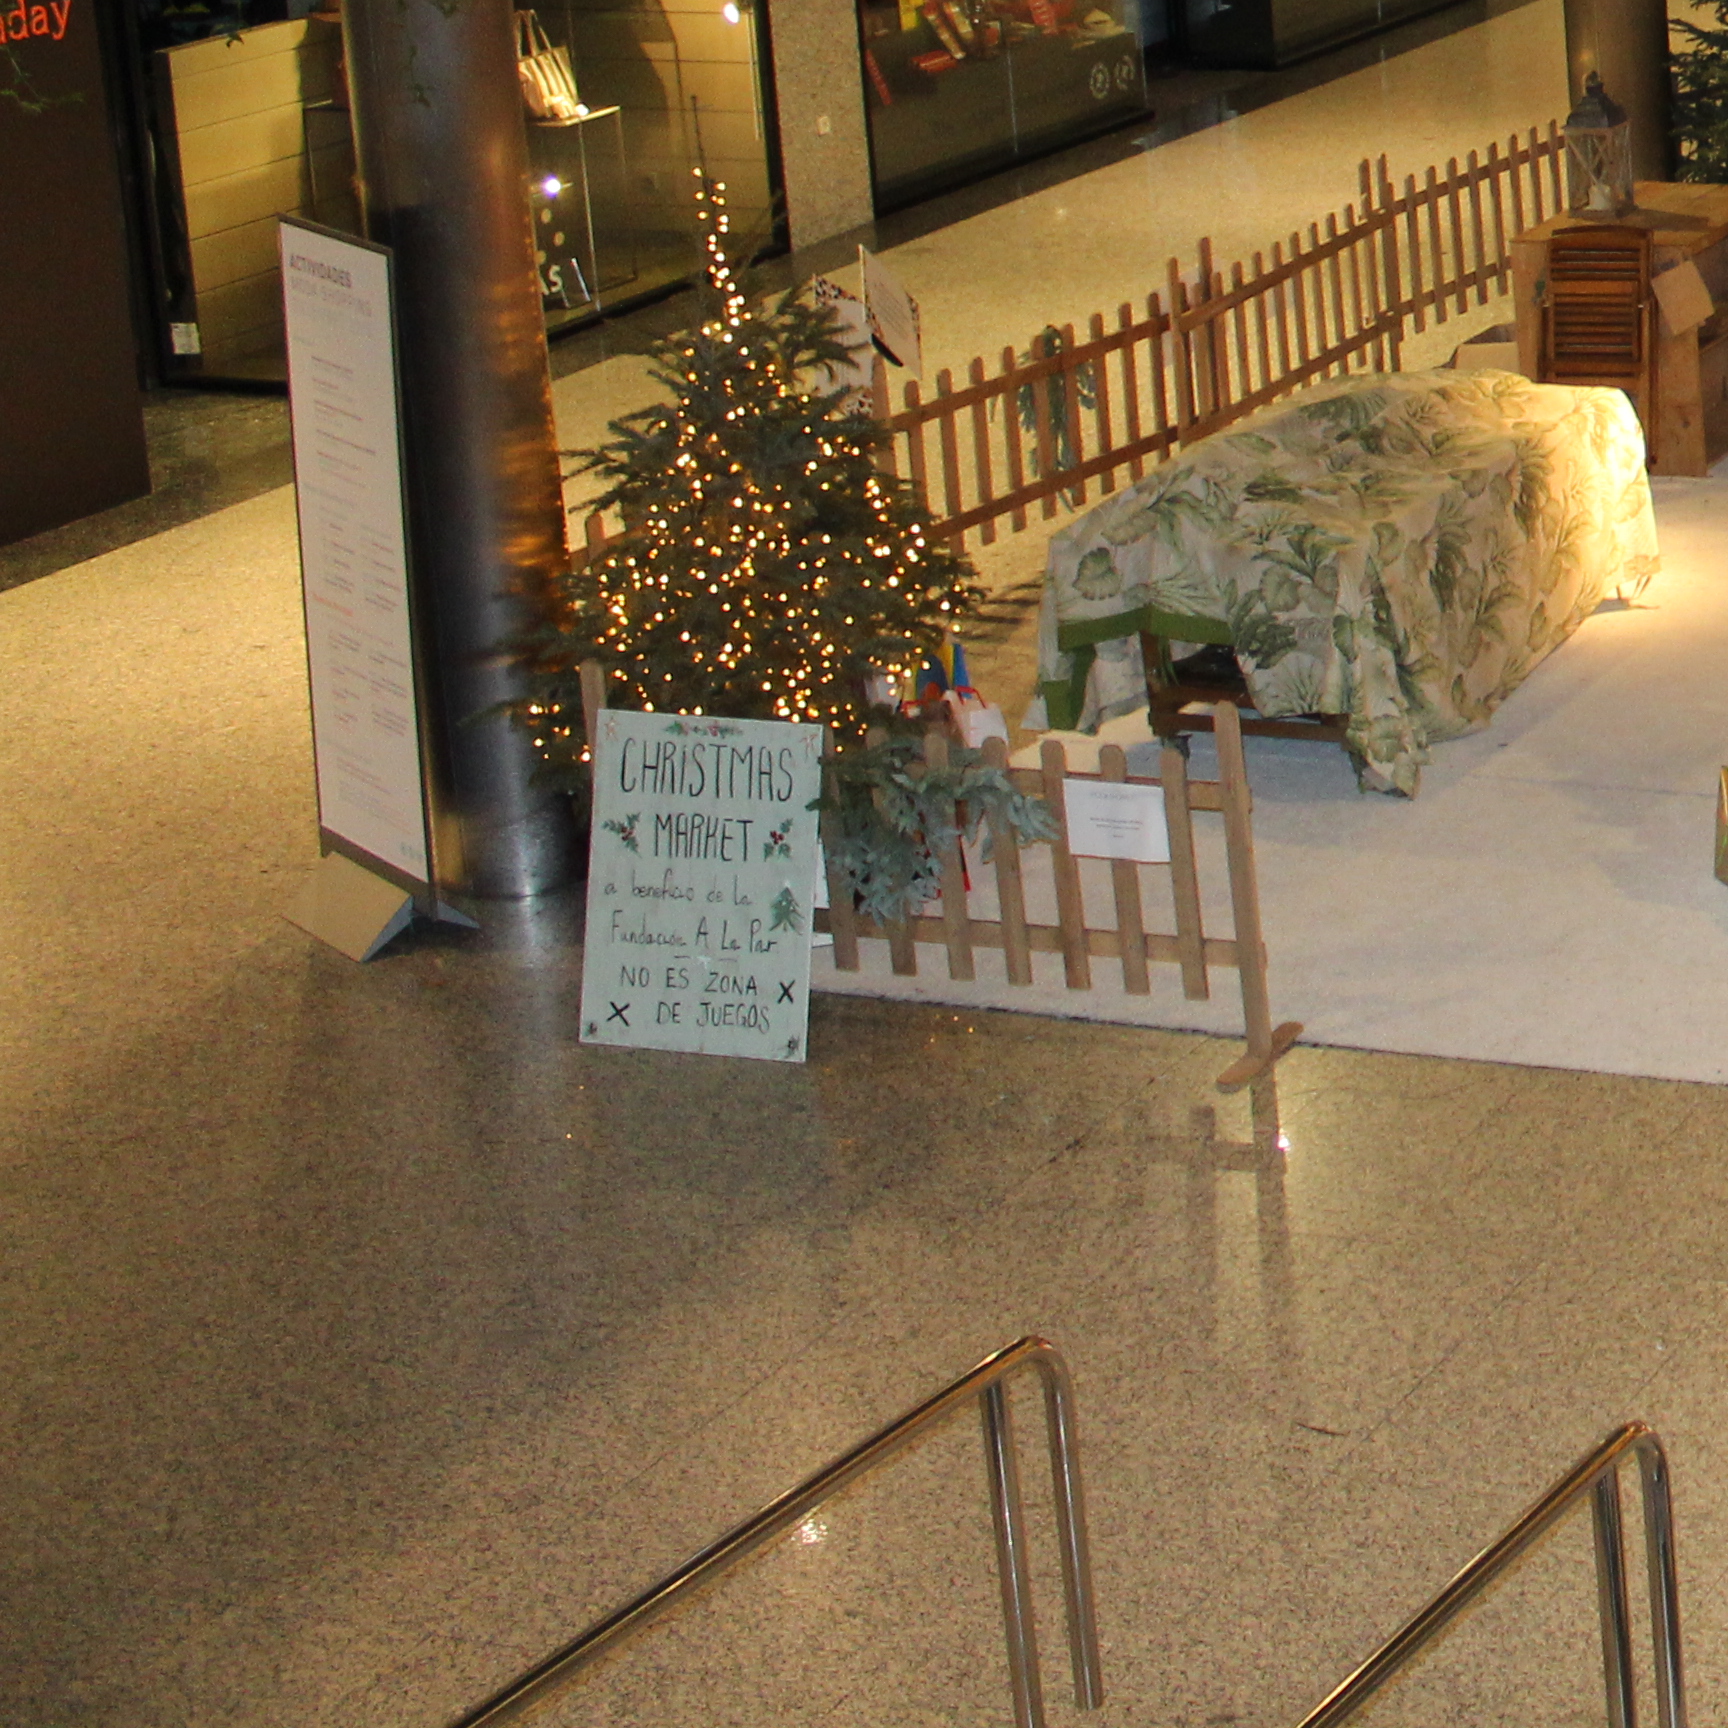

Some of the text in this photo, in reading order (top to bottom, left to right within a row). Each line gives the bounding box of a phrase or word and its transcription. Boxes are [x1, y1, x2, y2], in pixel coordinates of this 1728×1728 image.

[654, 813, 754, 863] MARKET
[707, 883, 725, 903] de
[695, 916, 710, 950] A
[620, 966, 758, 997] NO ES ZONA
[656, 1001, 770, 1034] DE JUEGOS
